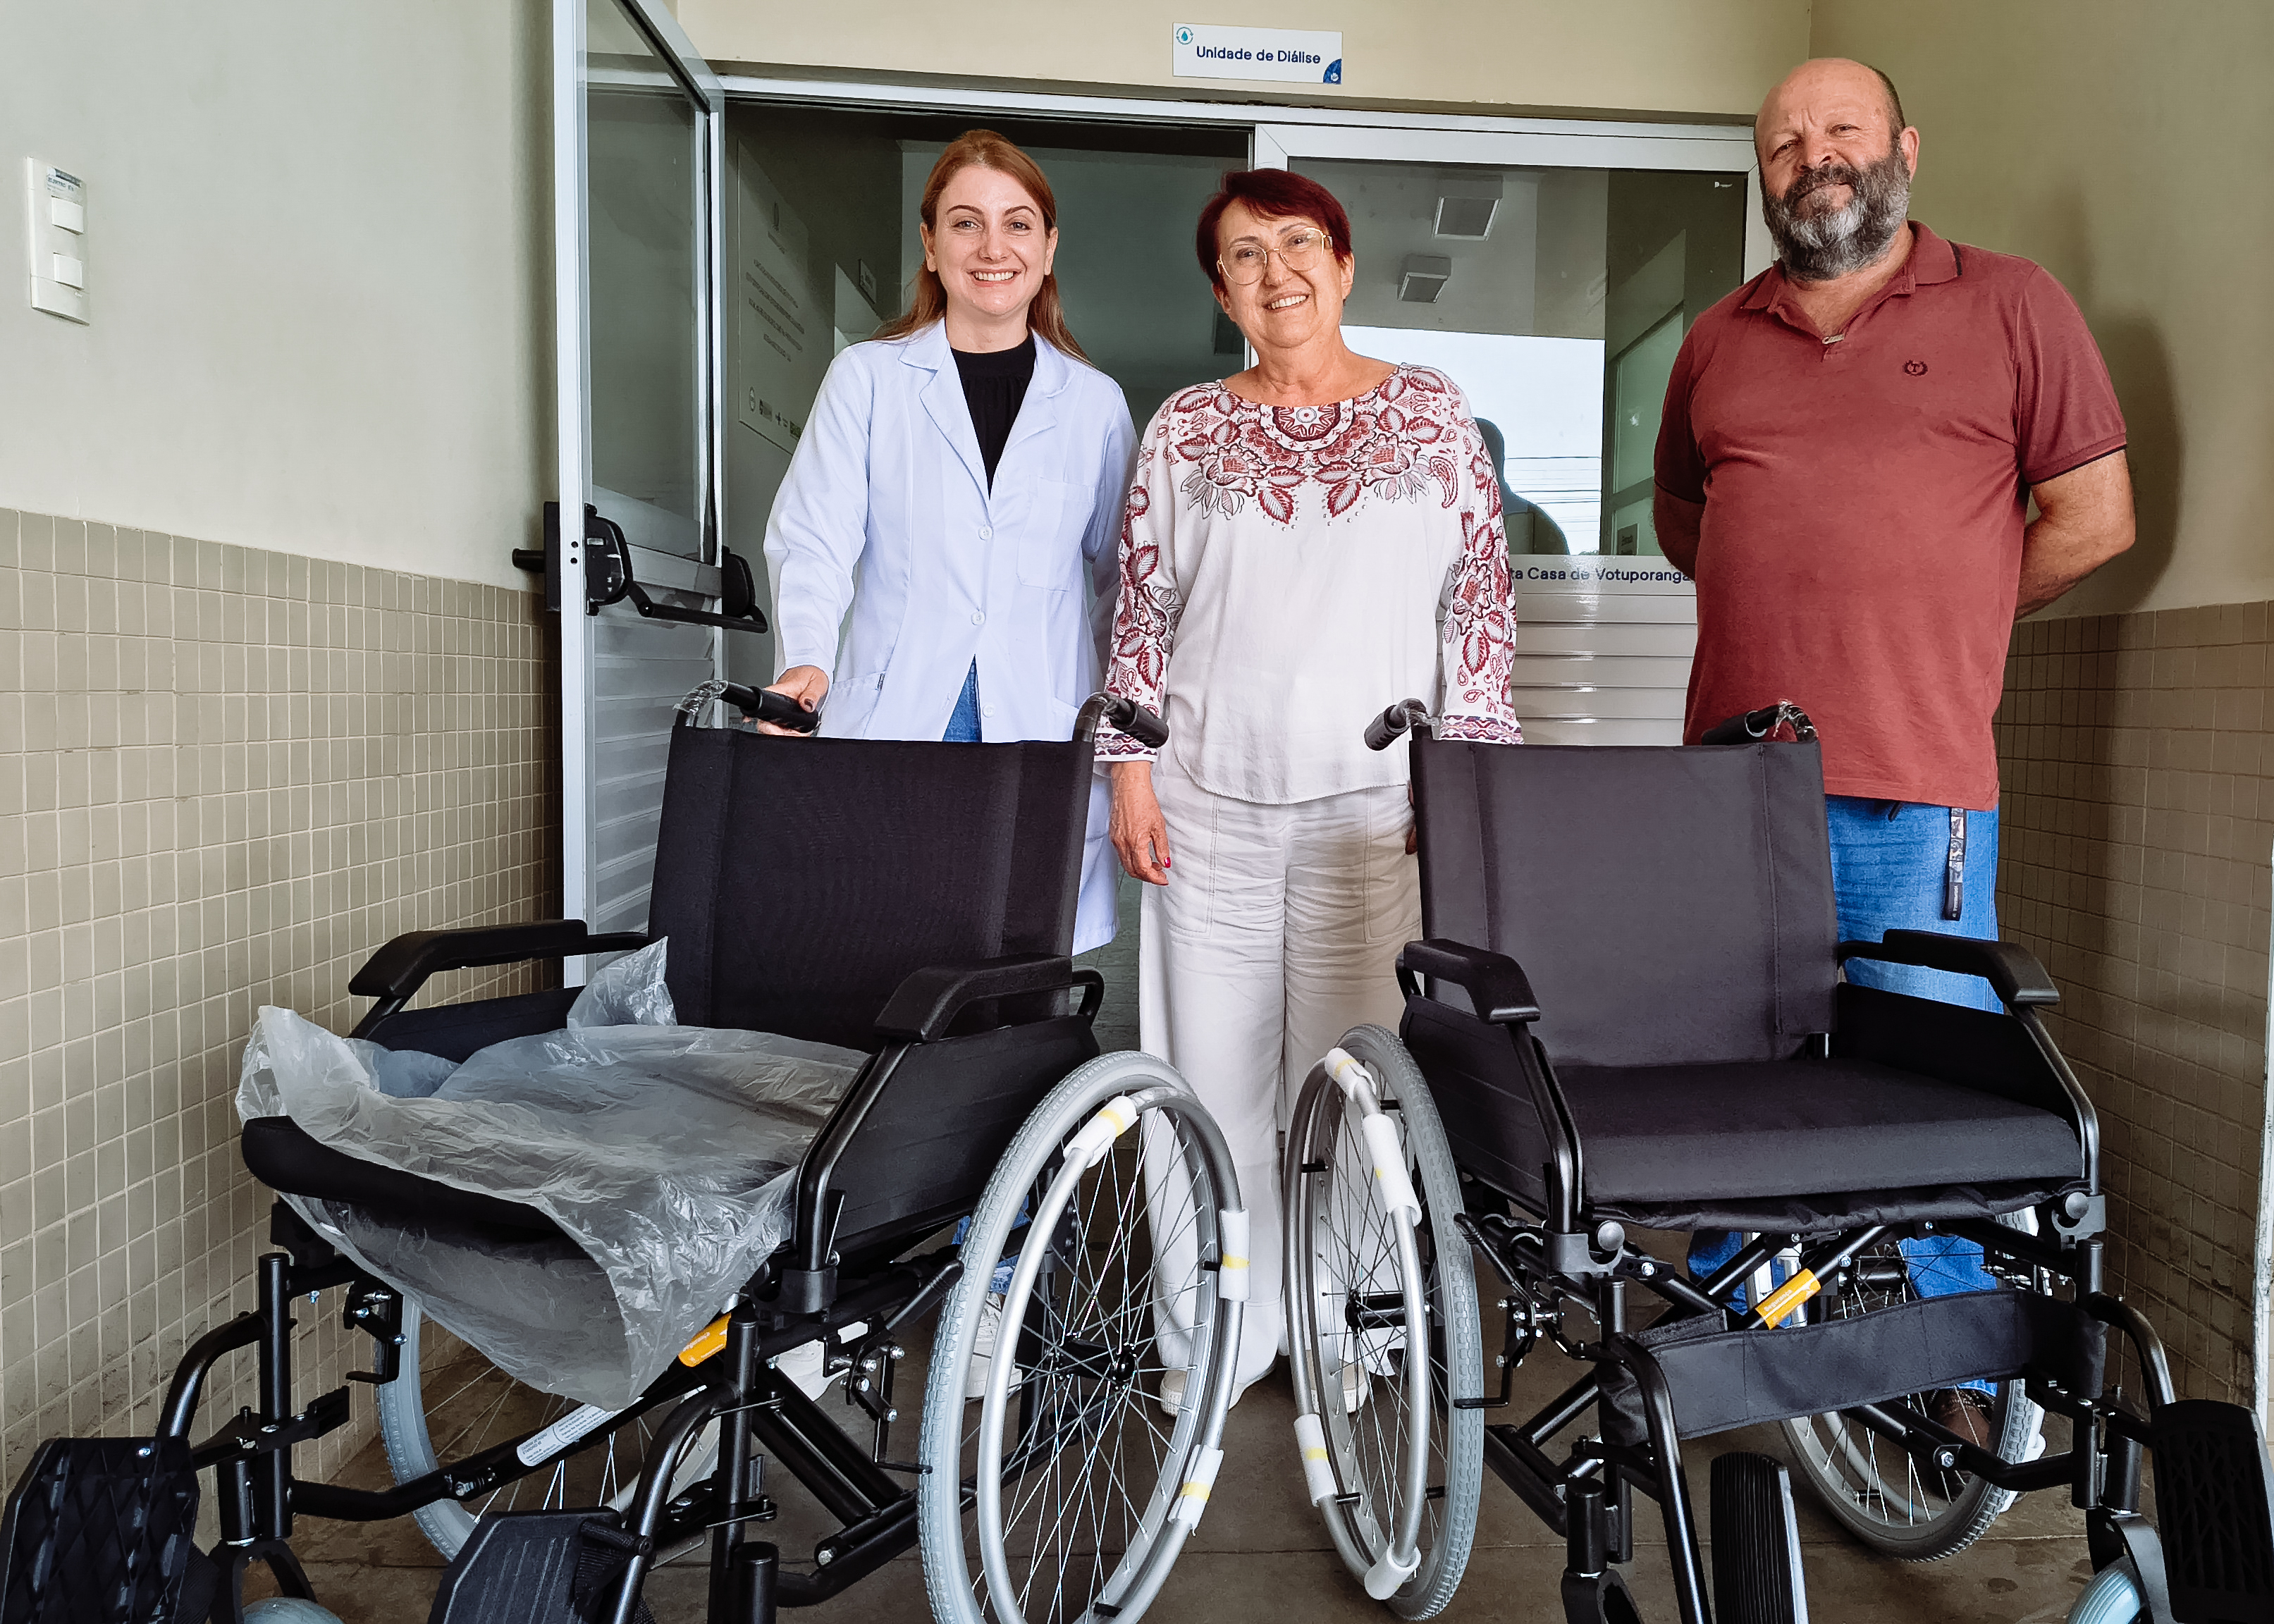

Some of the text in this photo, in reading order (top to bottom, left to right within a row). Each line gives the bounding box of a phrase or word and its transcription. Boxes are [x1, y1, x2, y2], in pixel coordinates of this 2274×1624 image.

[1196, 46, 1320, 64] Unidade de Diálise
[1528, 567, 1566, 579] Casa
[1571, 567, 1590, 579] de
